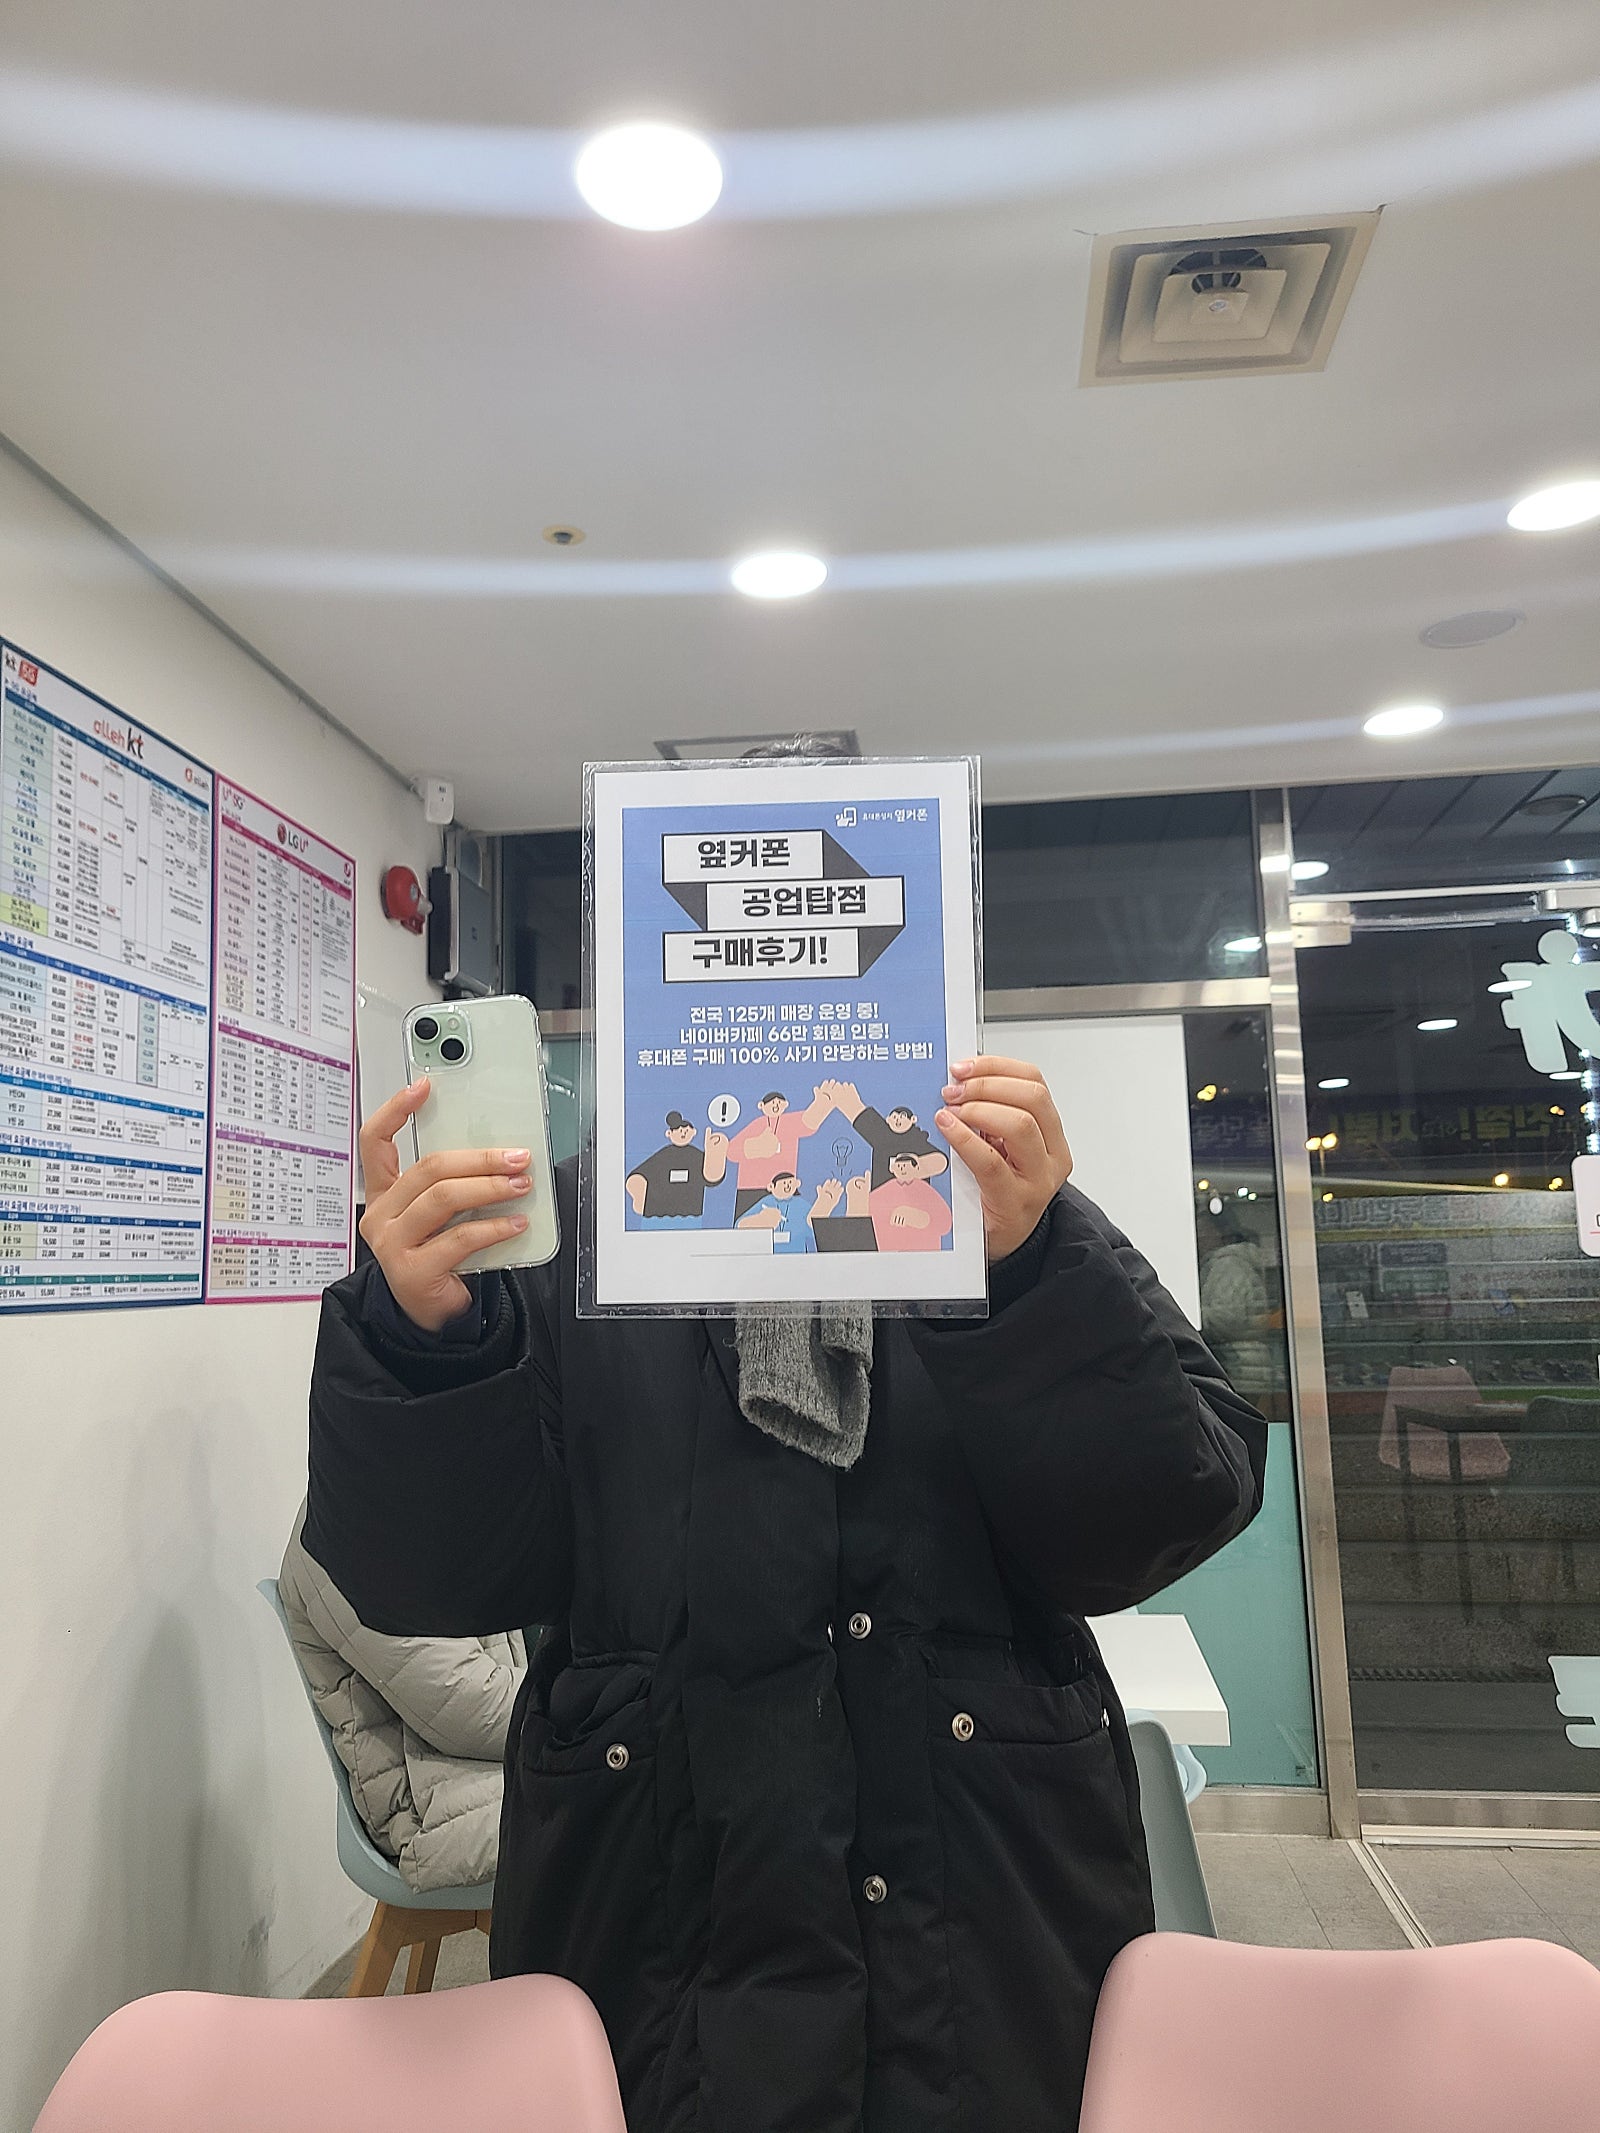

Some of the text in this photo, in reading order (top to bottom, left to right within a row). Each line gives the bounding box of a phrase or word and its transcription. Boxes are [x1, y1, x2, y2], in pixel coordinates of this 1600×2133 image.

[5, 652, 16, 671] kt
[93, 719, 144, 760] alleh kt
[895, 808, 928, 823] 옆커폰
[288, 830, 299, 850] LG
[698, 838, 790, 869] 옆커폰
[743, 885, 866, 917] 공업탑점
[693, 936, 828, 968] 구매후기!
[690, 1002, 879, 1024] 전국 125개 매장 운영 중!
[680, 1022, 890, 1045] 네이버카페 66만 회원 인증!
[637, 1042, 934, 1067] 휴대폰 구매 100% 사기 안당하는 방법!
